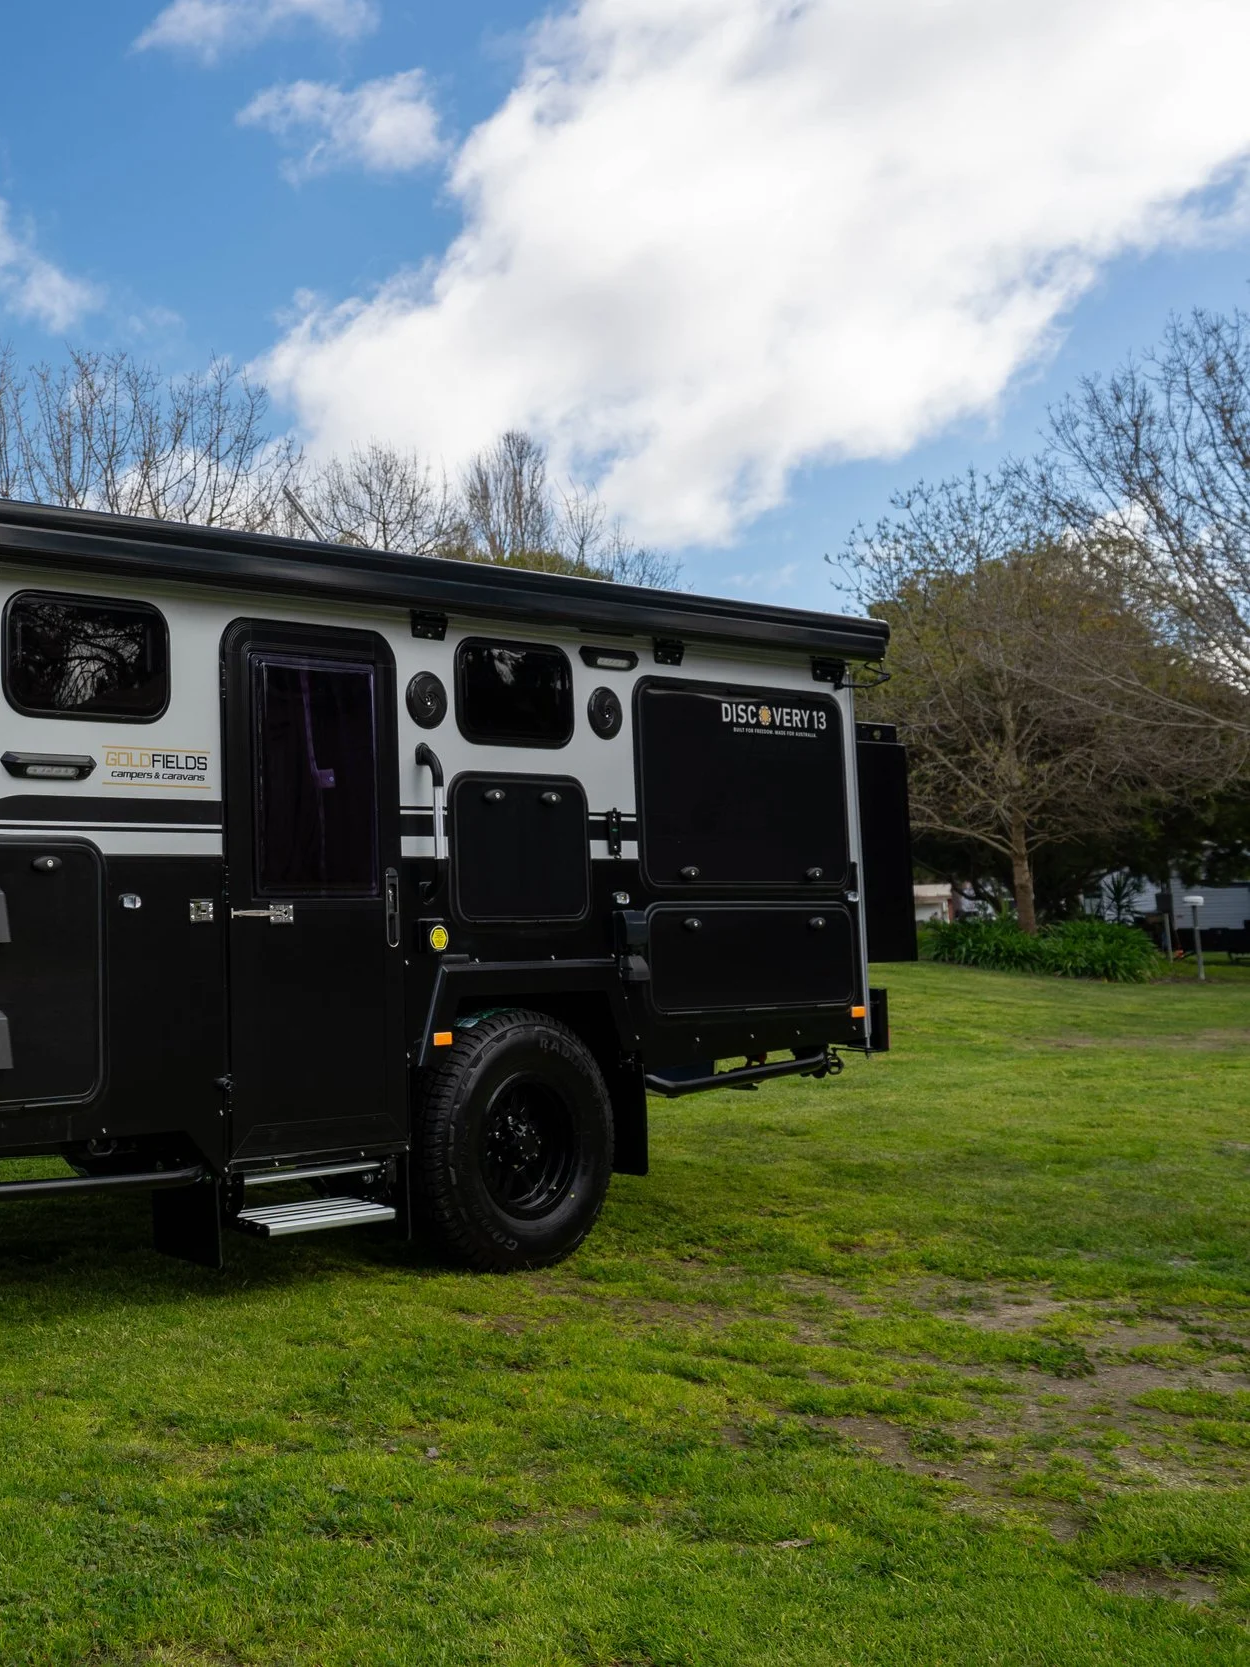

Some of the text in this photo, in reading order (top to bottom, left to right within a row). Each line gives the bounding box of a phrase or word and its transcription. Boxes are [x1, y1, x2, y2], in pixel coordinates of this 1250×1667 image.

[812, 710, 827, 730] 13
[105, 751, 208, 771] GOLDFIELDS
[111, 770, 206, 782] campers & caravans
